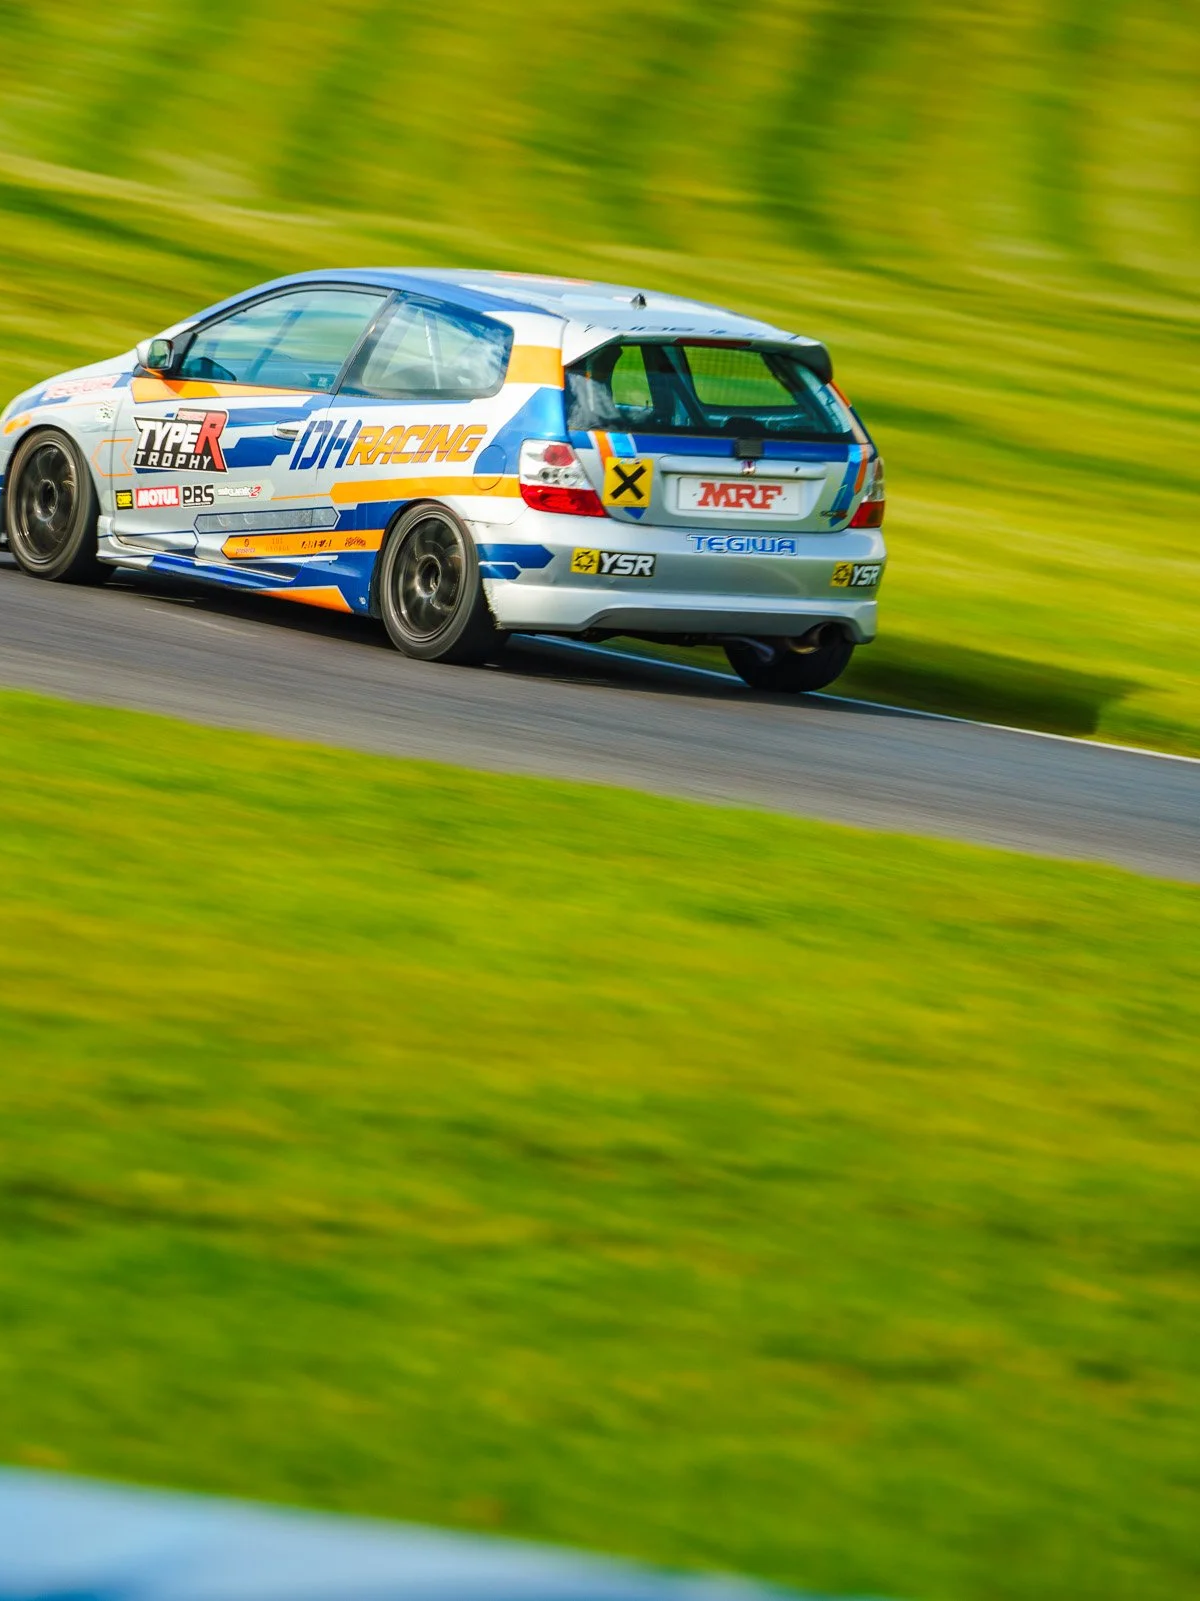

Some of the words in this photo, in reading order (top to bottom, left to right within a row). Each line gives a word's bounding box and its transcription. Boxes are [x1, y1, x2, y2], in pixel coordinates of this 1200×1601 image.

[136, 451, 212, 470] TROPHY
[137, 487, 179, 506] MOTUL
[696, 482, 783, 510] MRF
[688, 534, 797, 555] TEGIWA
[600, 552, 655, 576] YSR
[850, 564, 880, 586] YSR
